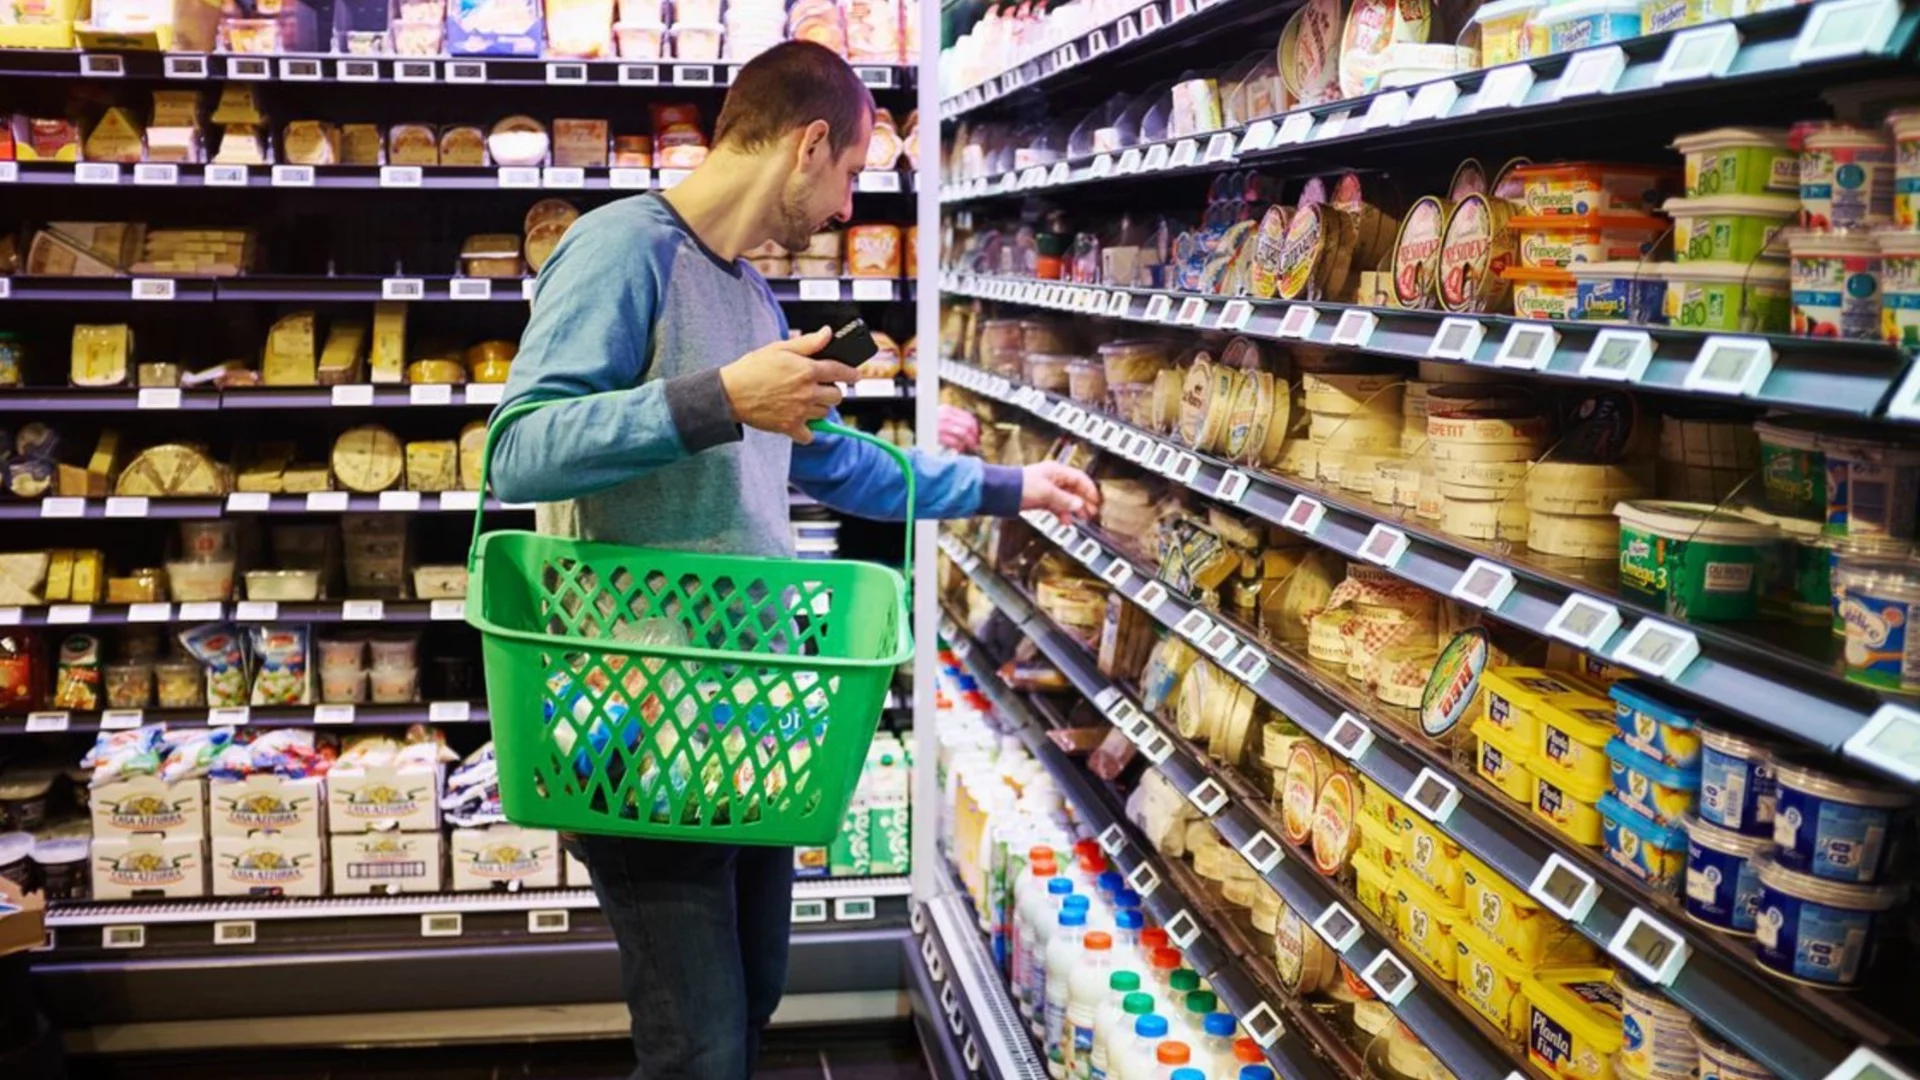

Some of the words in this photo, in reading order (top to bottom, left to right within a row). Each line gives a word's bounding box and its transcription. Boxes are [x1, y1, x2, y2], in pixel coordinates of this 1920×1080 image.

[1698, 169, 1721, 196] BIO
[1689, 235, 1713, 261] BIO
[1681, 301, 1706, 326] BIO
[1655, 567, 1668, 590] 3
[112, 813, 136, 825] CASA
[138, 813, 183, 825] AZZURRA
[230, 813, 253, 824] CASA
[255, 812, 299, 825] AZZURRA
[111, 869, 136, 881] CASA
[138, 868, 181, 881] AZZURRA
[231, 868, 255, 879] CASA
[257, 868, 301, 880] AZZURRA
[1533, 1010, 1569, 1056] Planta
[1537, 1036, 1554, 1061] Fin
